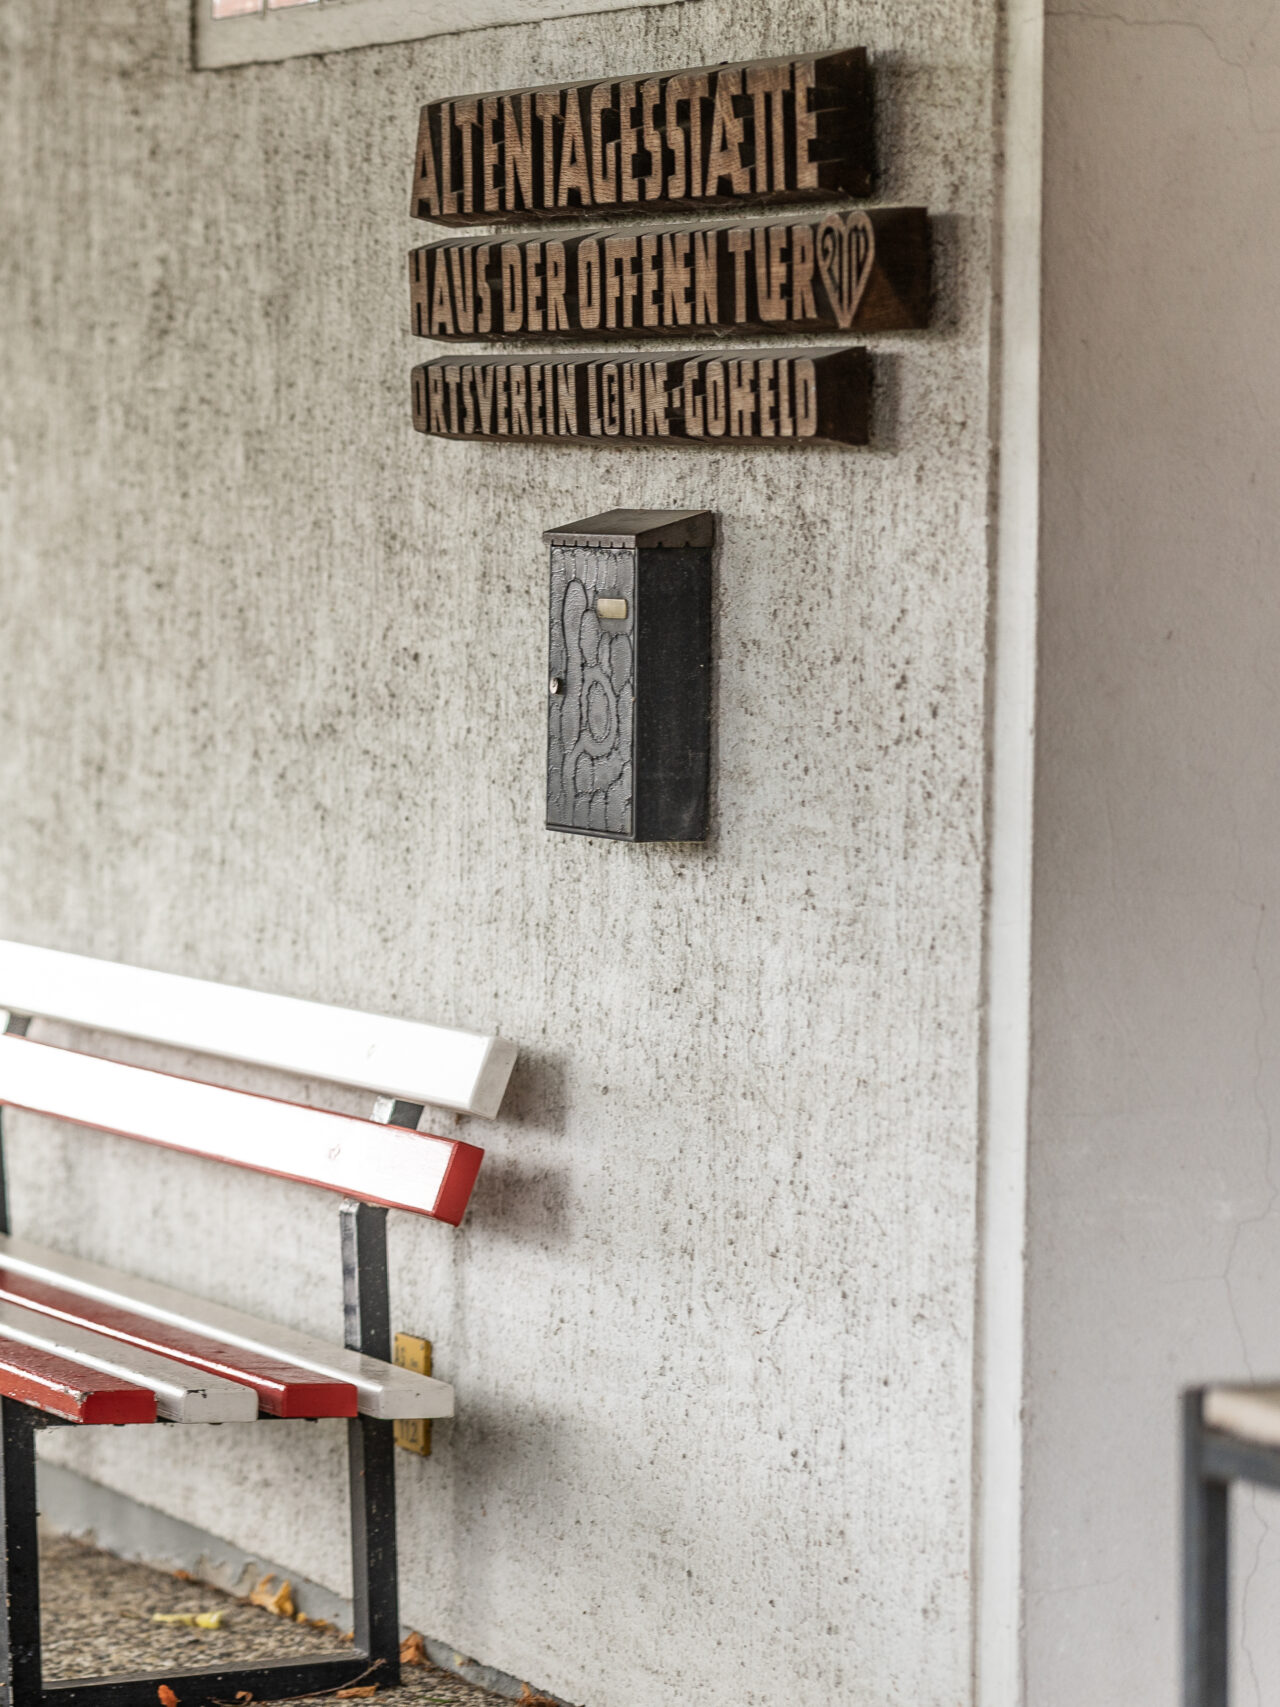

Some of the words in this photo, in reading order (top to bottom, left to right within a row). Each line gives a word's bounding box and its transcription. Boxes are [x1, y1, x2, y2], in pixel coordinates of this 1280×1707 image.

[409, 244, 492, 336] HAUS
[501, 240, 570, 333] DER
[411, 363, 578, 436] ORTSVEREIN
